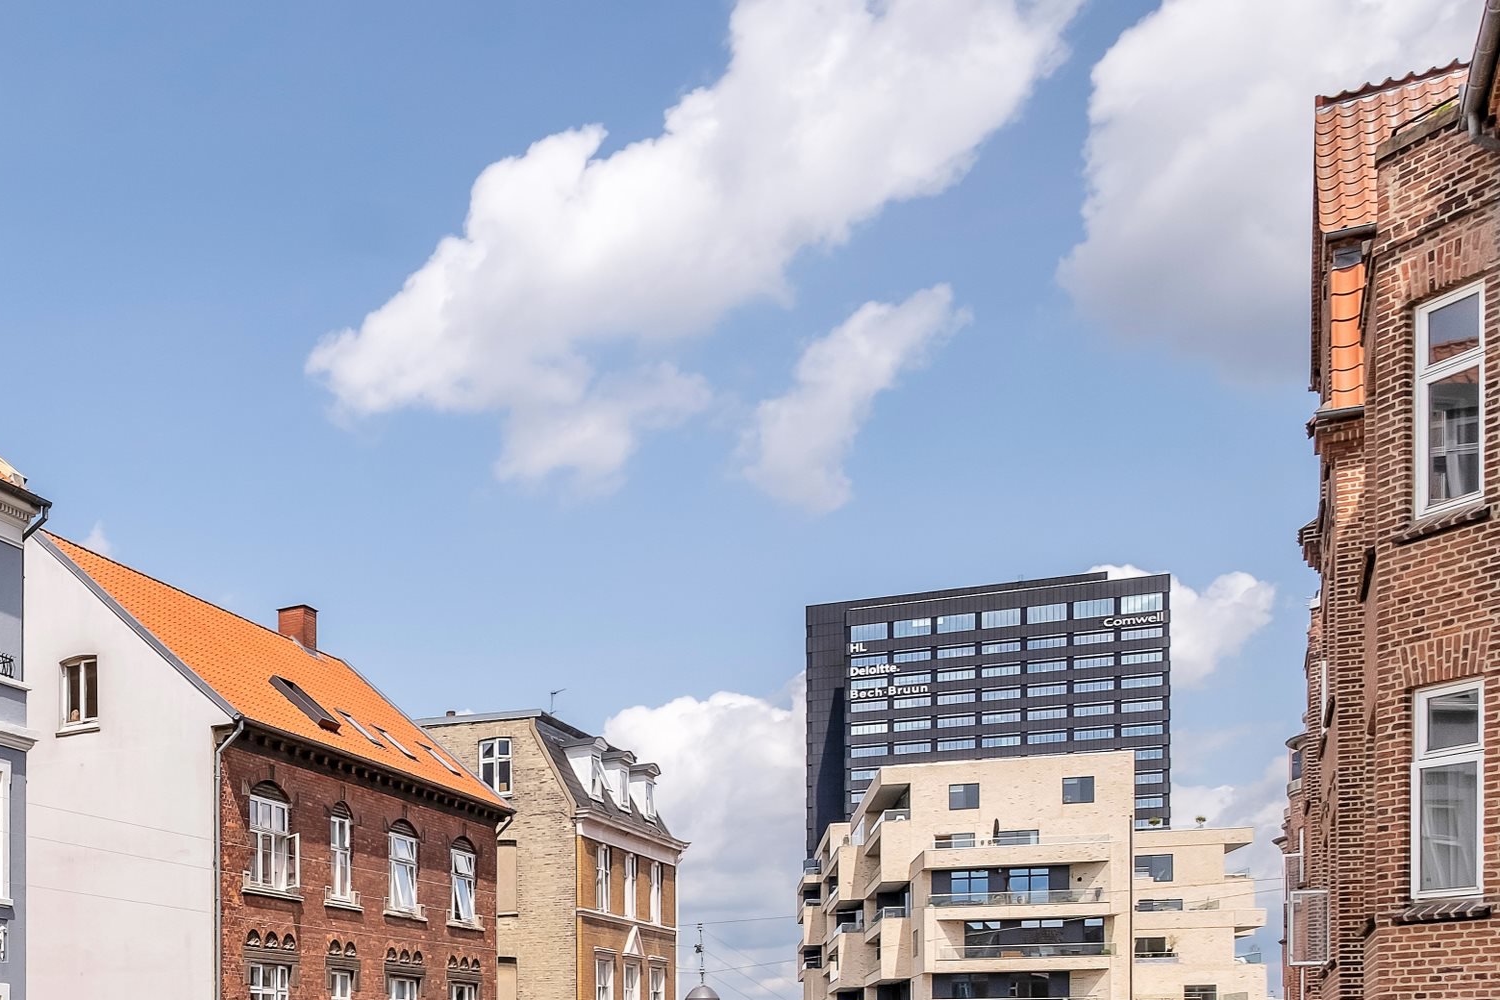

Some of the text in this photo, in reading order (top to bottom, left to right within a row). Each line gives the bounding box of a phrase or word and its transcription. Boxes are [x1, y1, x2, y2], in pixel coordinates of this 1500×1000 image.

[1103, 611, 1164, 627] Comwell
[850, 643, 867, 653] HL
[850, 664, 900, 676] Deloitte.
